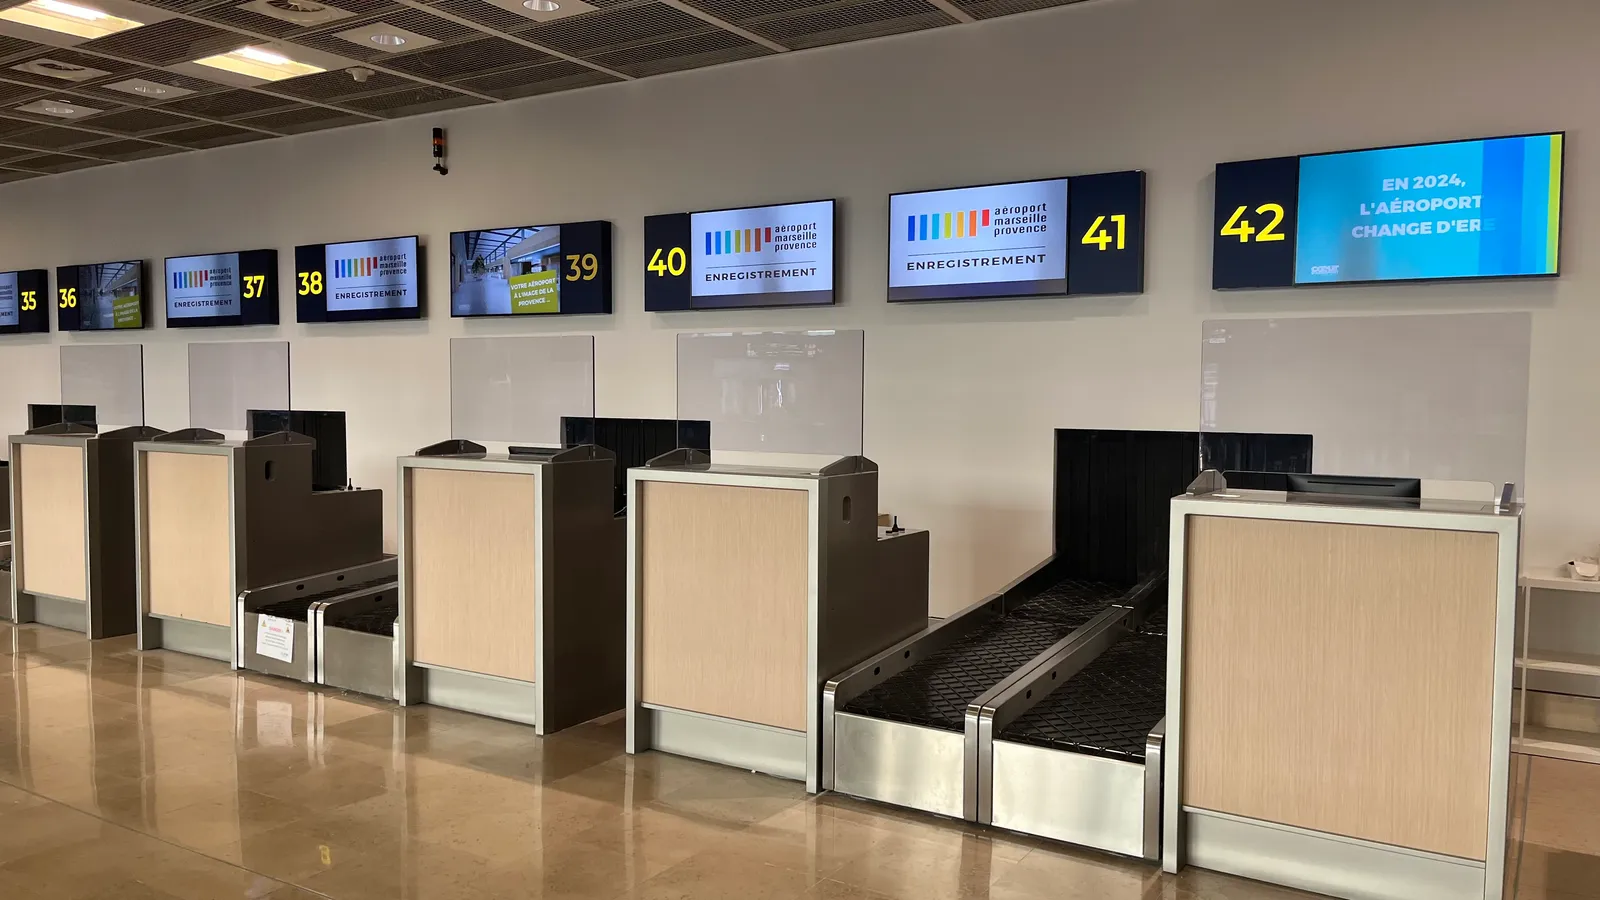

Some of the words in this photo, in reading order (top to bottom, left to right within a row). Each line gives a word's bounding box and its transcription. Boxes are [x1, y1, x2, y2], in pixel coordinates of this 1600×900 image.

[1382, 177, 1409, 192] EN
[1413, 173, 1466, 190] 2024,
[994, 203, 1047, 217] aéroport
[1360, 194, 1483, 216] L'AÉROPORT
[774, 222, 817, 234] aéroport
[994, 213, 1047, 226] marseille
[1220, 203, 1286, 243] 42
[774, 231, 817, 243] marseille
[994, 224, 1047, 238] provence
[1081, 214, 1126, 251] 41
[1351, 221, 1433, 239] CHANGE
[774, 241, 817, 253] provence
[565, 253, 598, 282] 39
[647, 246, 687, 277] 40
[907, 254, 1047, 271] ENREGISTREMENT
[705, 267, 817, 282] ENREGISTREMENT
[243, 275, 265, 299] 37
[298, 271, 323, 296] 38
[510, 282, 527, 291] VOTRE
[528, 277, 556, 288] AÉROPORT
[21, 290, 37, 311] 35
[59, 287, 77, 309] 36
[335, 289, 408, 300] ENREGISTREMENT
[518, 297, 545, 307] PROVENCE
[174, 299, 233, 308] ENREGISTREMENT
